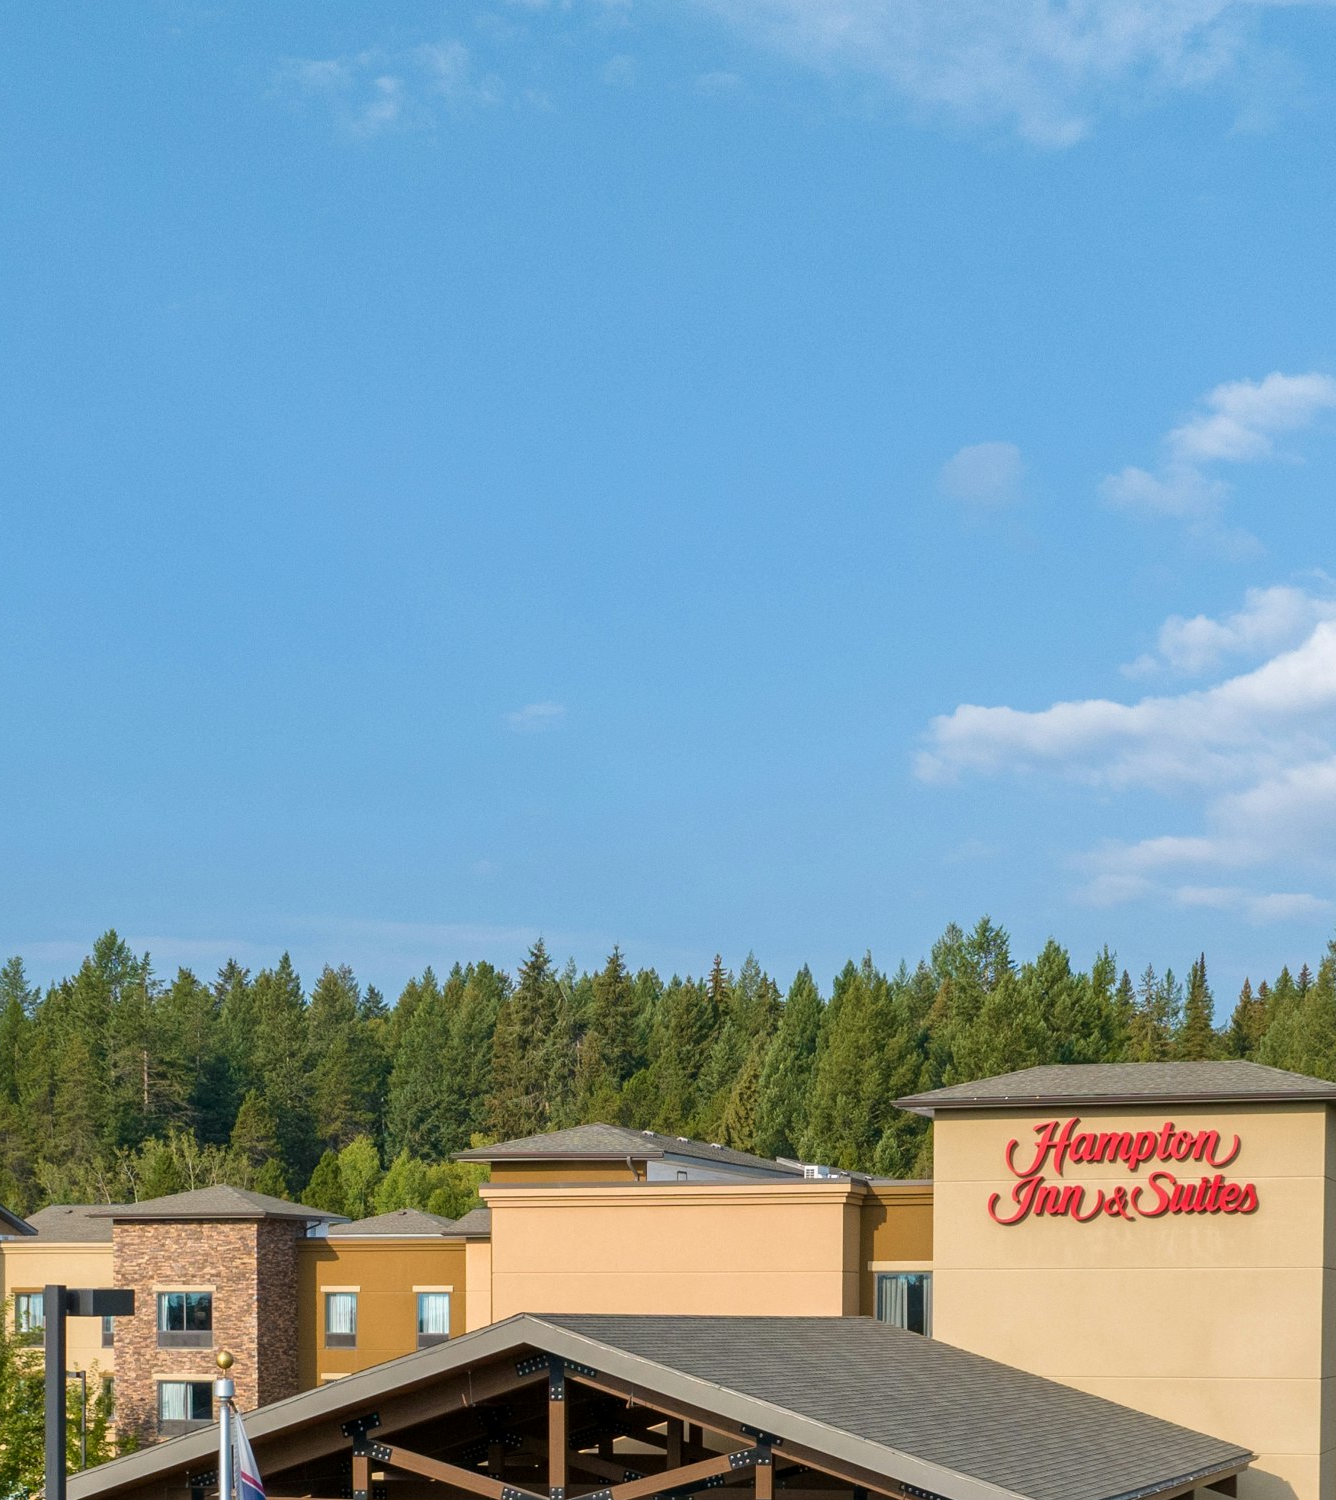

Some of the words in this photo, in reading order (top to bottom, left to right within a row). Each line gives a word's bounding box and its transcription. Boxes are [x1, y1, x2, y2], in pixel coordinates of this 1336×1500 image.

[1005, 1116, 1242, 1178] Hampton
[987, 1175, 1105, 1225] Inn
[1103, 1186, 1134, 1221] &
[1130, 1171, 1258, 1216] Suites
